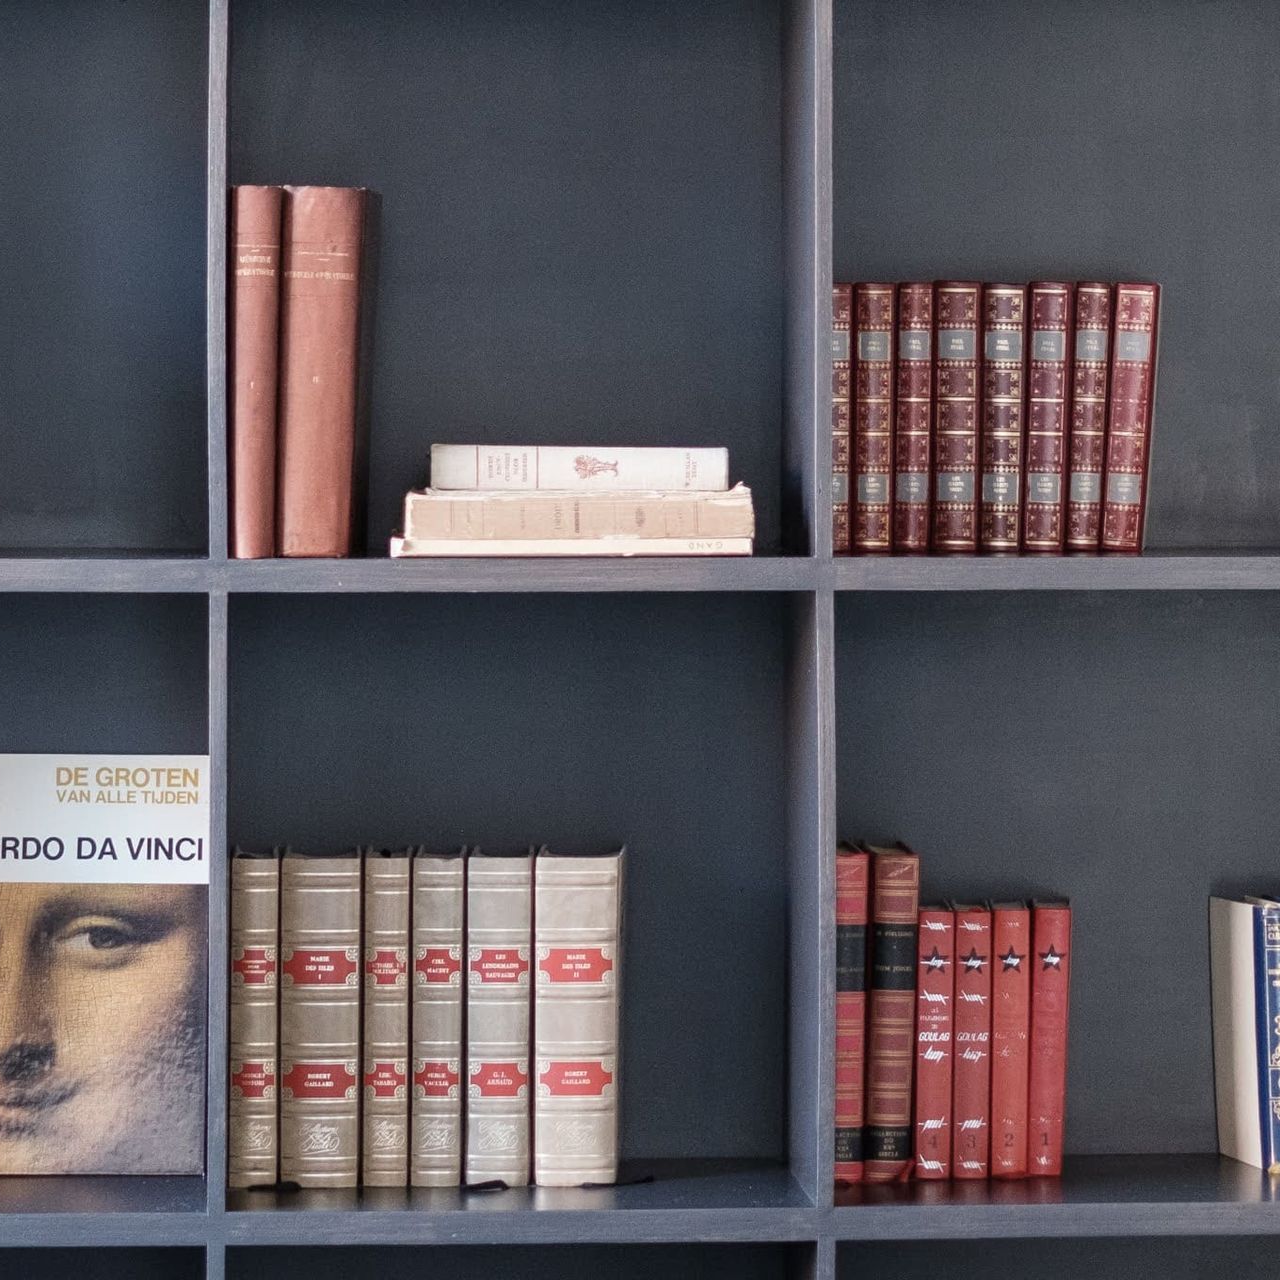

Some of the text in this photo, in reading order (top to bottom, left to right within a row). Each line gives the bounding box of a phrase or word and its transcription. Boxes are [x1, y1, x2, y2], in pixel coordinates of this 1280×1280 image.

[56, 767, 200, 787] DE GROTEN
[56, 790, 200, 804] VAN ALLE TIJDEN
[76, 837, 118, 860] DA
[127, 837, 204, 861] VINCI
[919, 1030, 950, 1043] GOULAG
[927, 1135, 938, 1150] 4
[967, 1135, 977, 1149] 3
[1004, 1134, 1014, 1148] 2
[1041, 1132, 1048, 1146] 1
